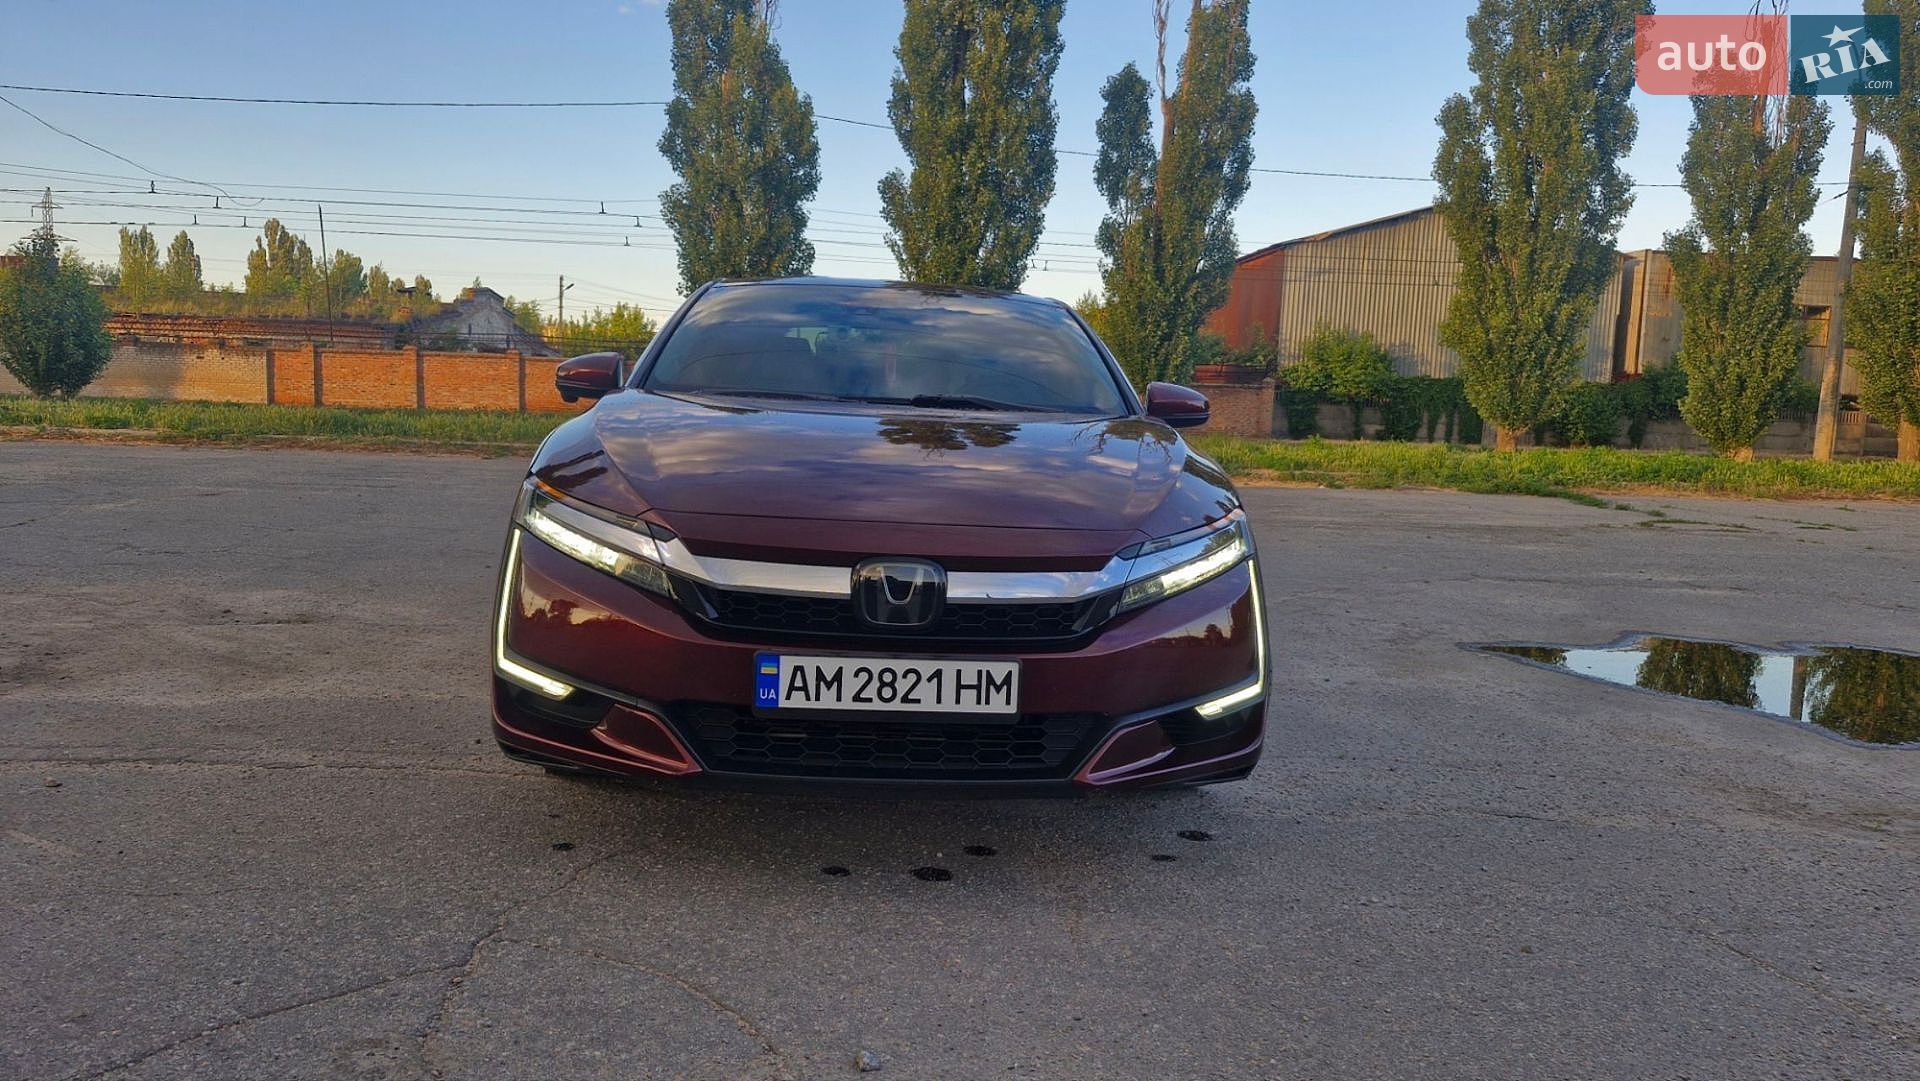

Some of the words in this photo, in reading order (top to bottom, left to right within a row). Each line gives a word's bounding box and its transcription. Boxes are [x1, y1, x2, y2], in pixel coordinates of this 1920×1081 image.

[760, 688, 777, 700] UA
[784, 664, 843, 702] AM
[851, 666, 943, 704] 2821
[955, 668, 1013, 706] HM
